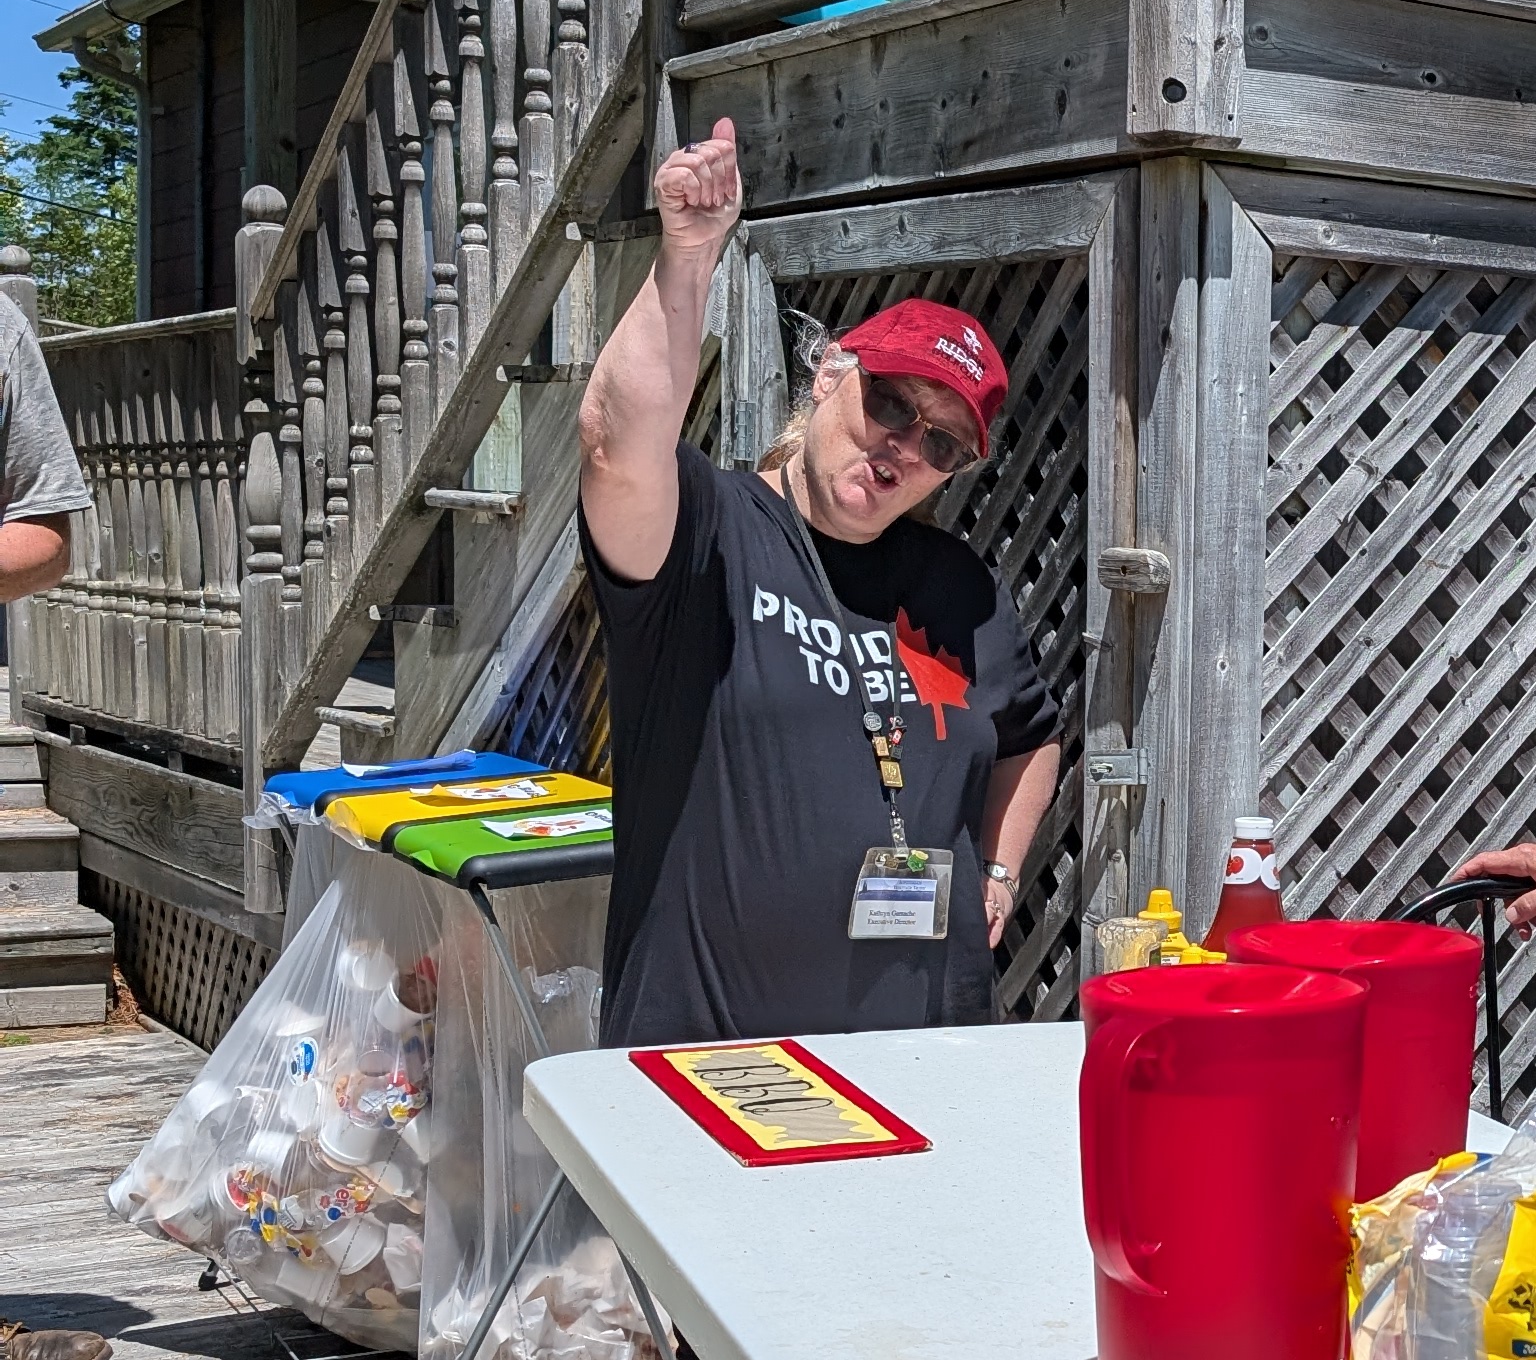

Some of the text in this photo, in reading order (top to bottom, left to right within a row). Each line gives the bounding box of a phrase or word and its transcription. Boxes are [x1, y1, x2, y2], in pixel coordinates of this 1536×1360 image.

[934, 337, 984, 382] RIDGE
[799, 645, 918, 703] TO BE
[690, 1063, 841, 1116] BBQ
